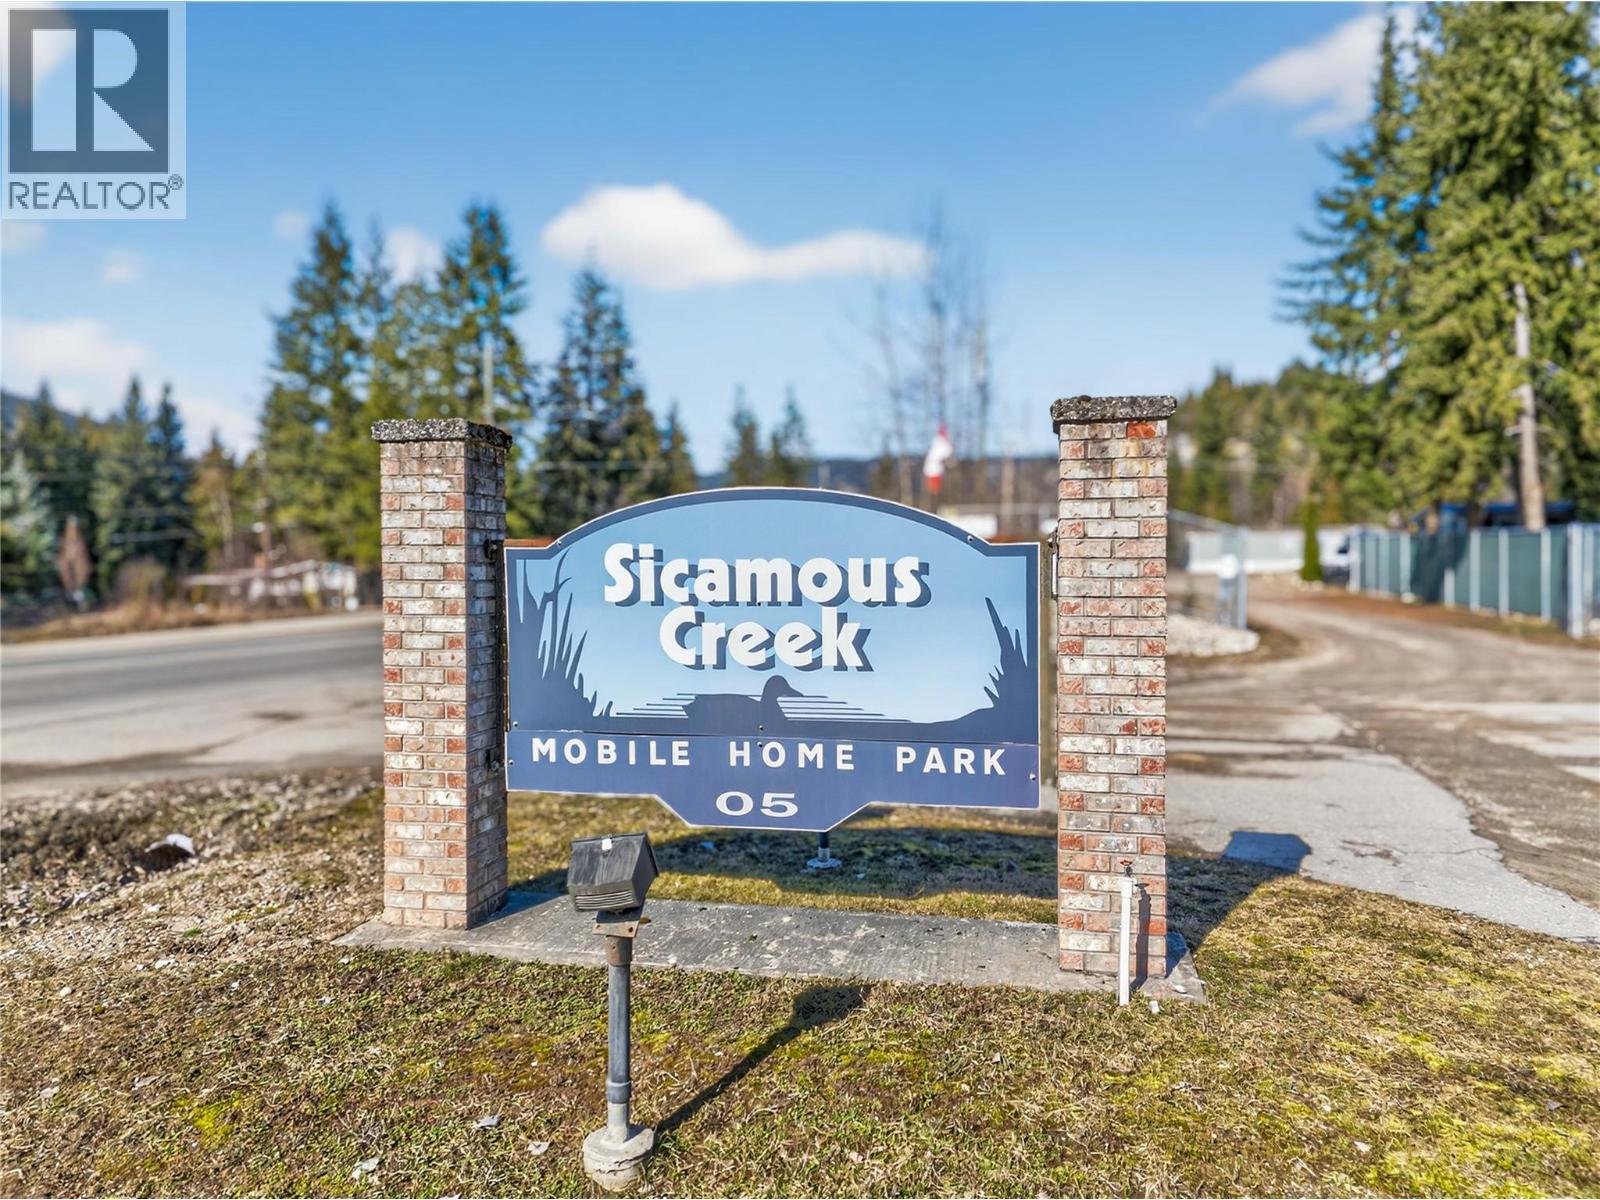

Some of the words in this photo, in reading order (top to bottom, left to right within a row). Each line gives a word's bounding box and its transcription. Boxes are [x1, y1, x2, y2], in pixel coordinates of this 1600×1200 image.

[603, 542, 932, 608] Sicamous
[659, 606, 874, 672] Creek
[531, 737, 691, 767] MOBILE
[729, 741, 855, 771] HOME
[896, 745, 1006, 776] PARK
[715, 791, 799, 818] 05
